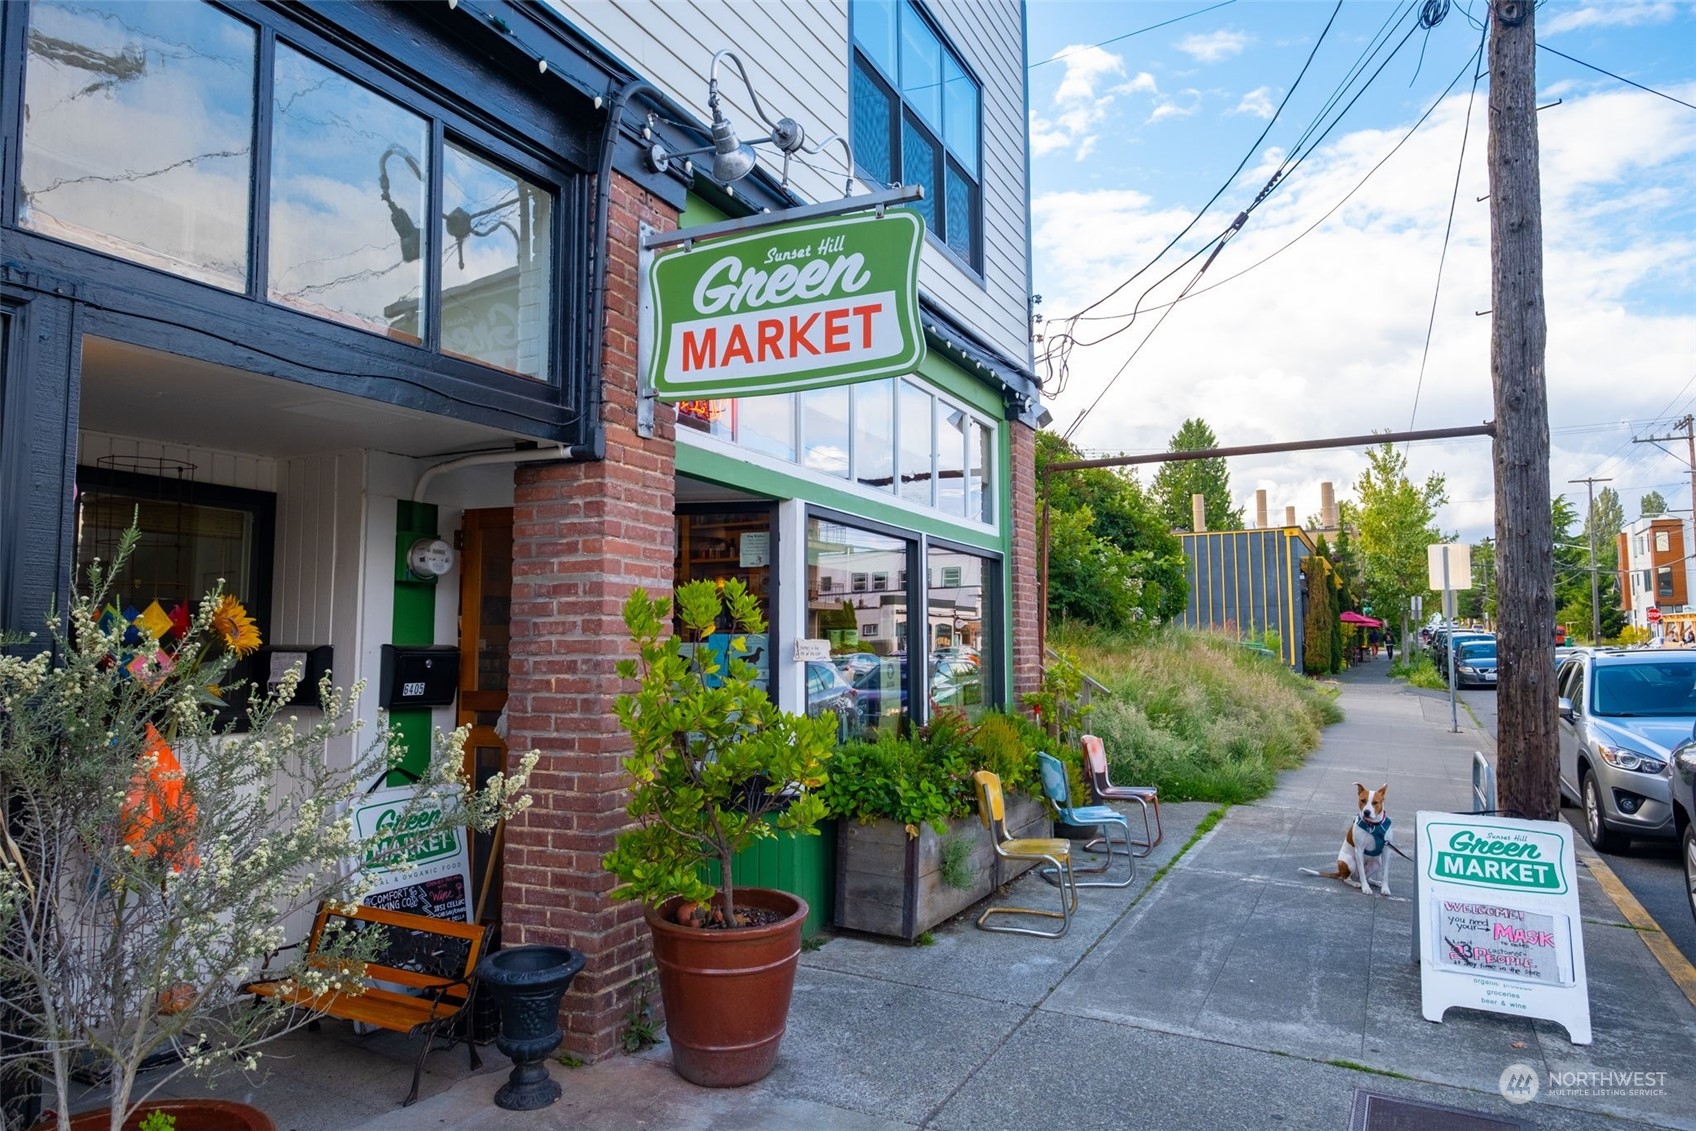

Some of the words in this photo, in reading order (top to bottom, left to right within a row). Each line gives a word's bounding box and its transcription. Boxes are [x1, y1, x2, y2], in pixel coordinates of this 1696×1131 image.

[764, 245, 811, 264] Sunset
[817, 235, 845, 254] Hill
[693, 252, 871, 314] Green
[682, 303, 882, 372] MARKET
[1647, 611, 1662, 619] STOP
[403, 683, 424, 695] 6405
[1449, 830, 1541, 859] Green
[1486, 832, 1511, 841] Sunset
[1514, 834, 1528, 842] Hill
[402, 867, 438, 880] ORGANIC
[442, 862, 462, 871] FOOD
[1443, 855, 1549, 884] MARKET
[371, 887, 409, 906] COMFORT
[373, 899, 400, 911] AKING
[1444, 901, 1525, 920] WELCOME!
[1448, 916, 1465, 925] you
[1469, 918, 1489, 927] need
[1456, 923, 1476, 932] your
[1493, 922, 1555, 949] MASK
[1473, 946, 1533, 969] PEOPLE
[1486, 989, 1520, 999] groceries
[1481, 998, 1497, 1006] beer
[1510, 1002, 1527, 1010] wine
